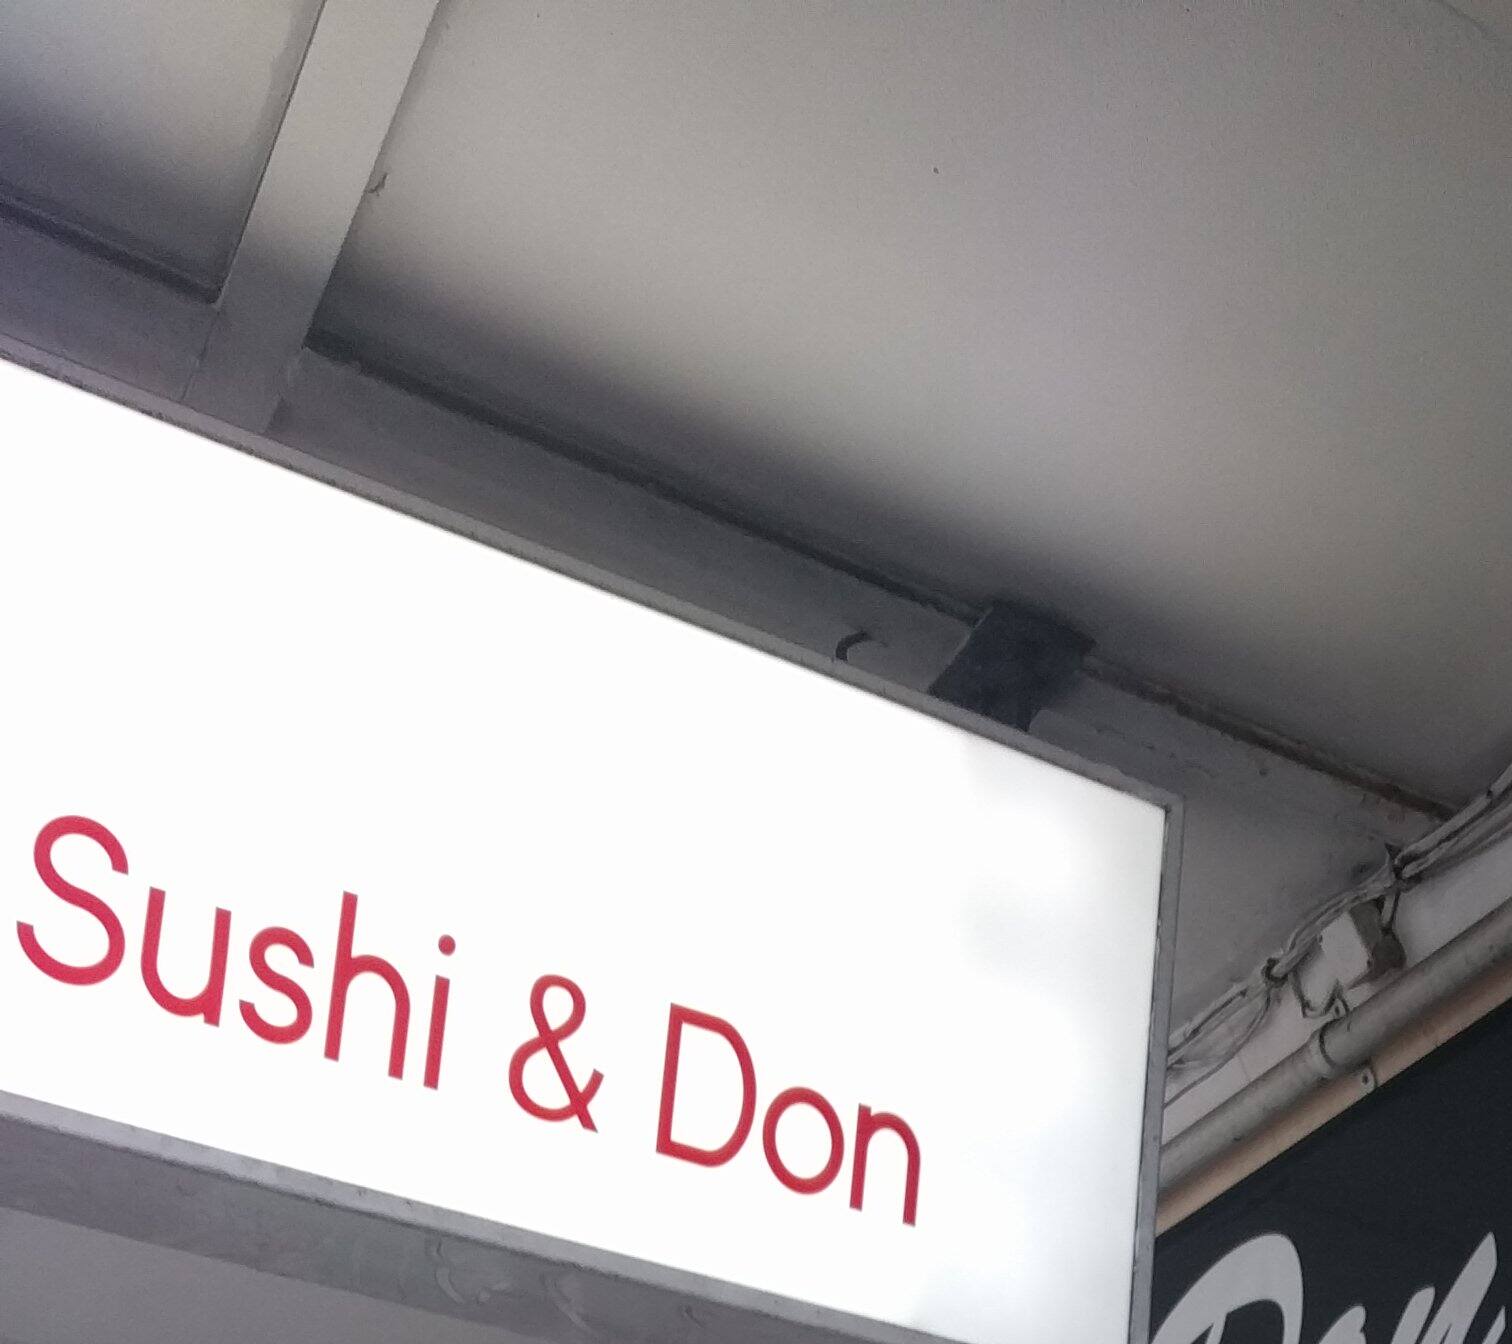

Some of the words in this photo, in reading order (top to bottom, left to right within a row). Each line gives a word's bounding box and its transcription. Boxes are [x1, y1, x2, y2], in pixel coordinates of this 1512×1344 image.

[16, 814, 456, 1090] Sushi
[507, 973, 605, 1132] &
[654, 1002, 922, 1227] Don
